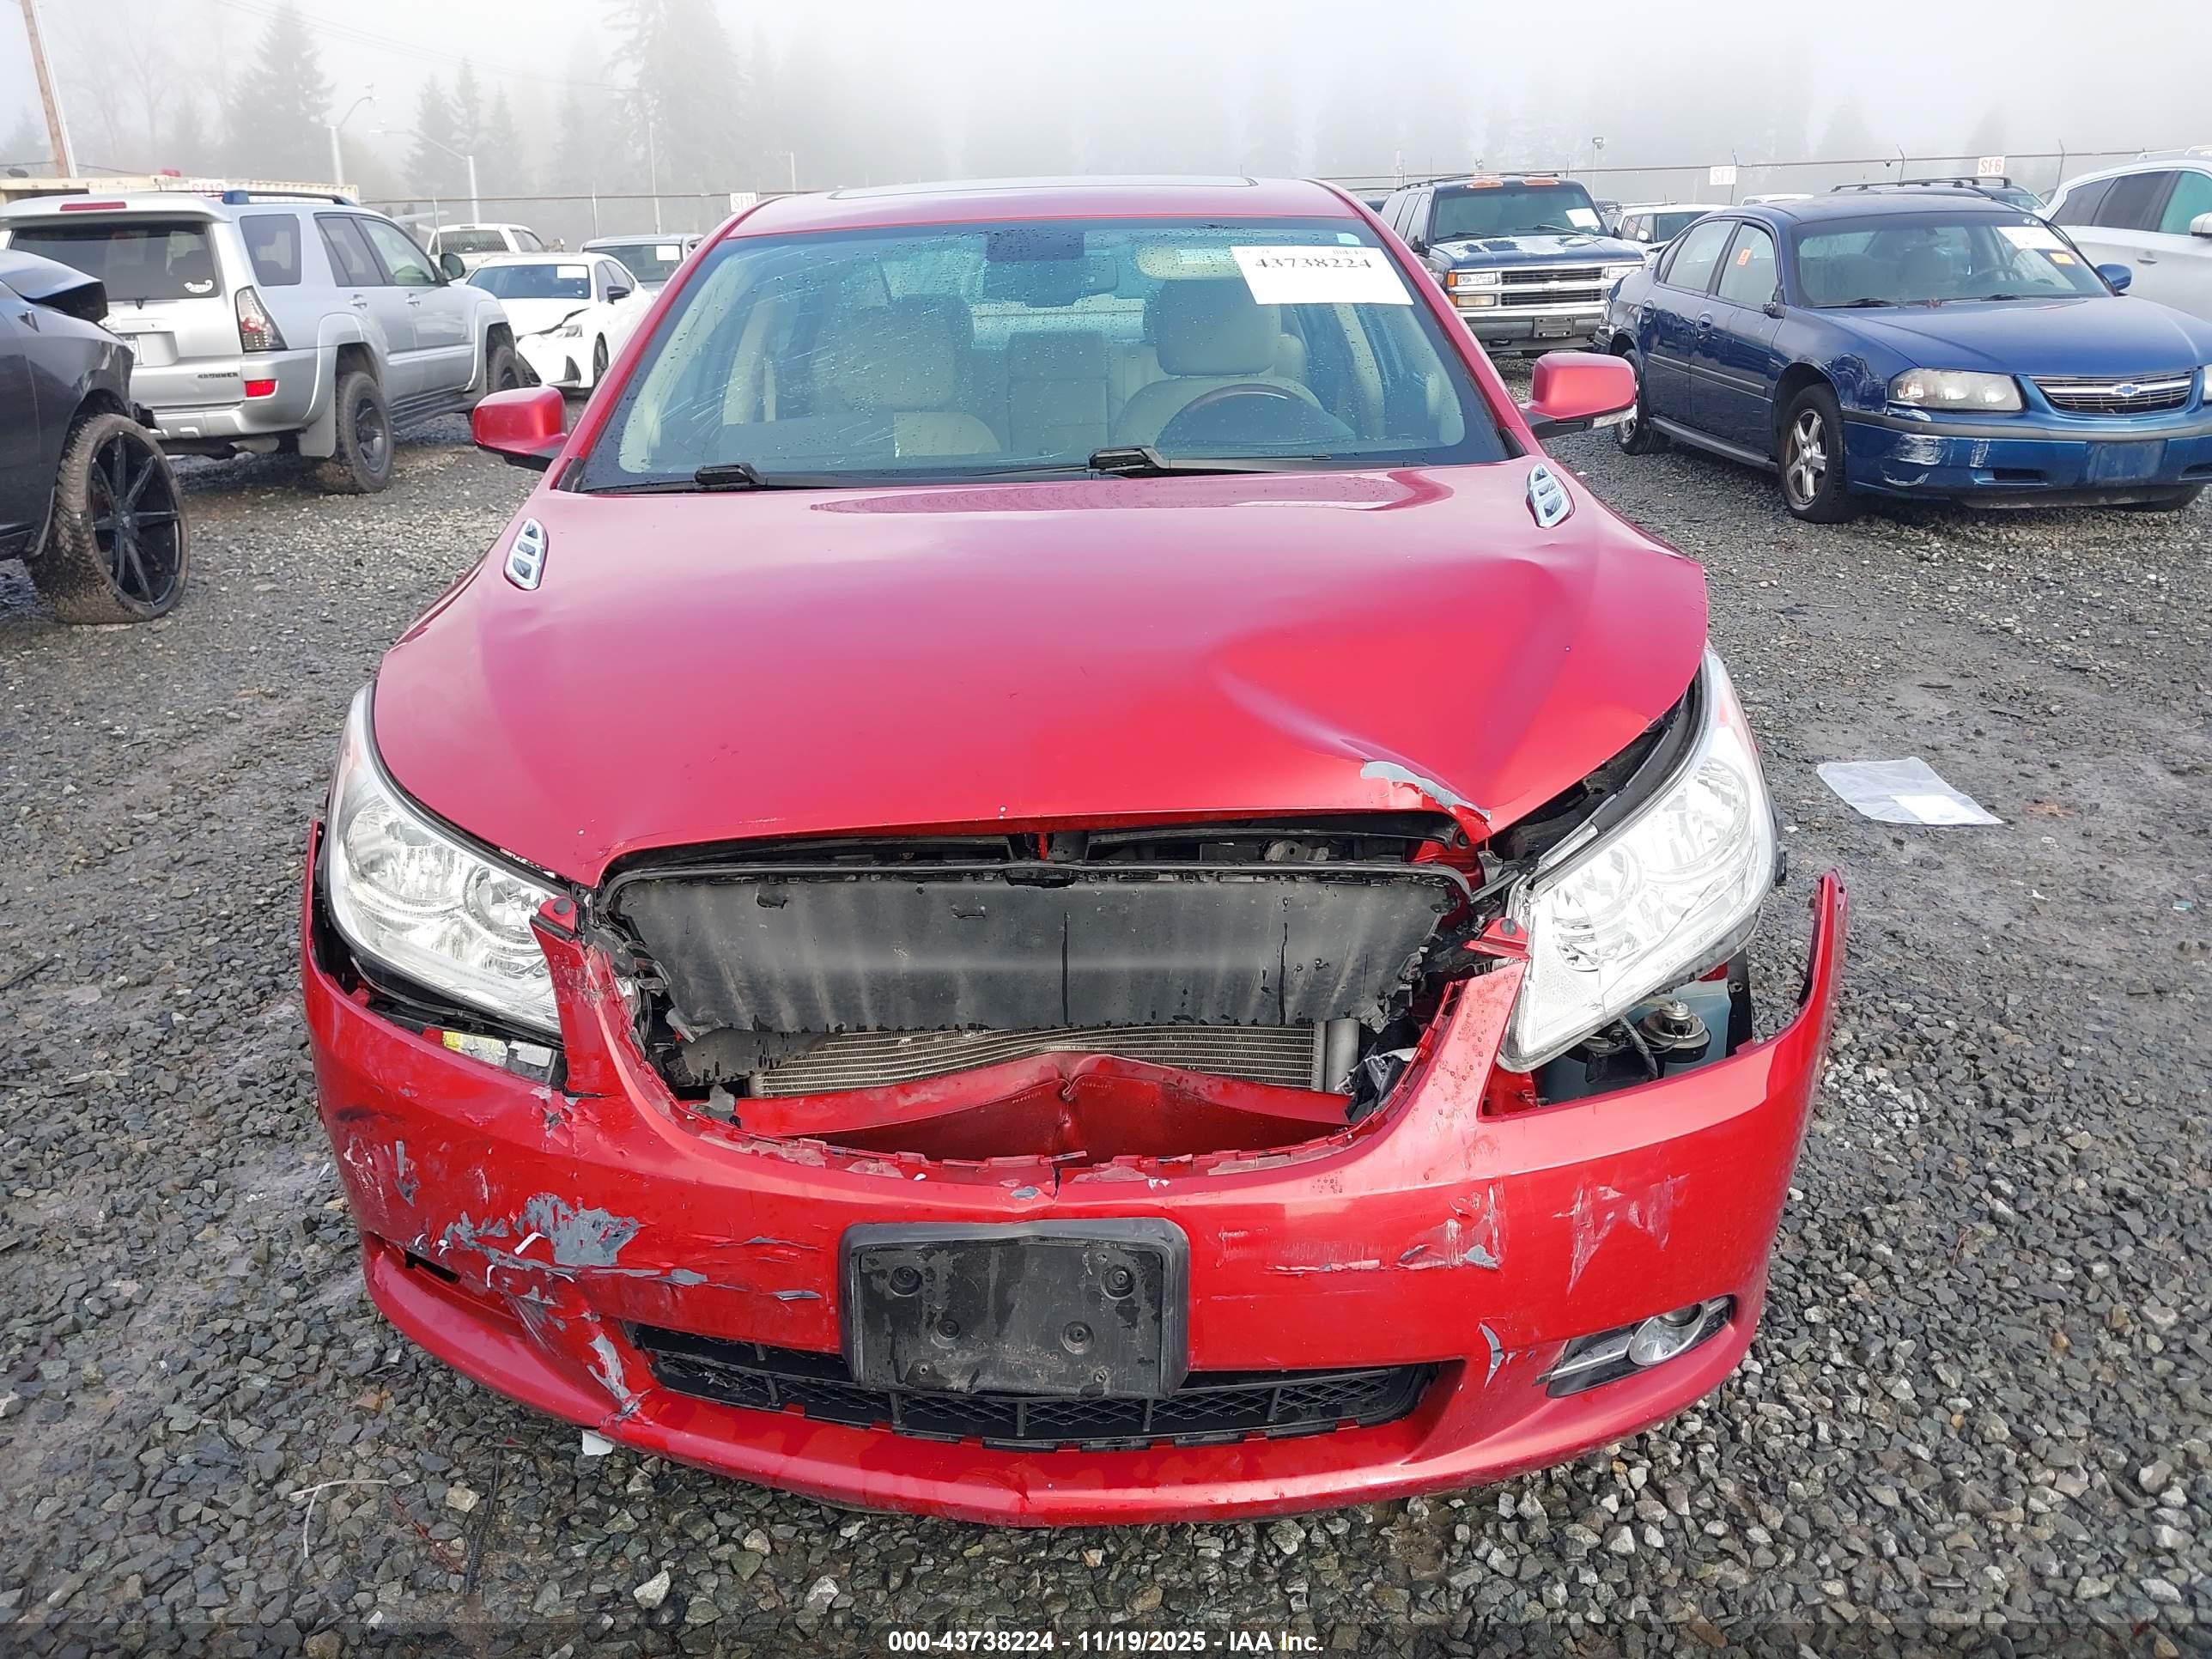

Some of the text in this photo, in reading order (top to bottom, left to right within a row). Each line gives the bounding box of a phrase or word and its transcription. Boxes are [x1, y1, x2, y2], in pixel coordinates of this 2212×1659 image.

[1980, 158, 2002, 173] SF6
[1711, 167, 1734, 183] SF7
[1255, 258, 1372, 269] 43738224
